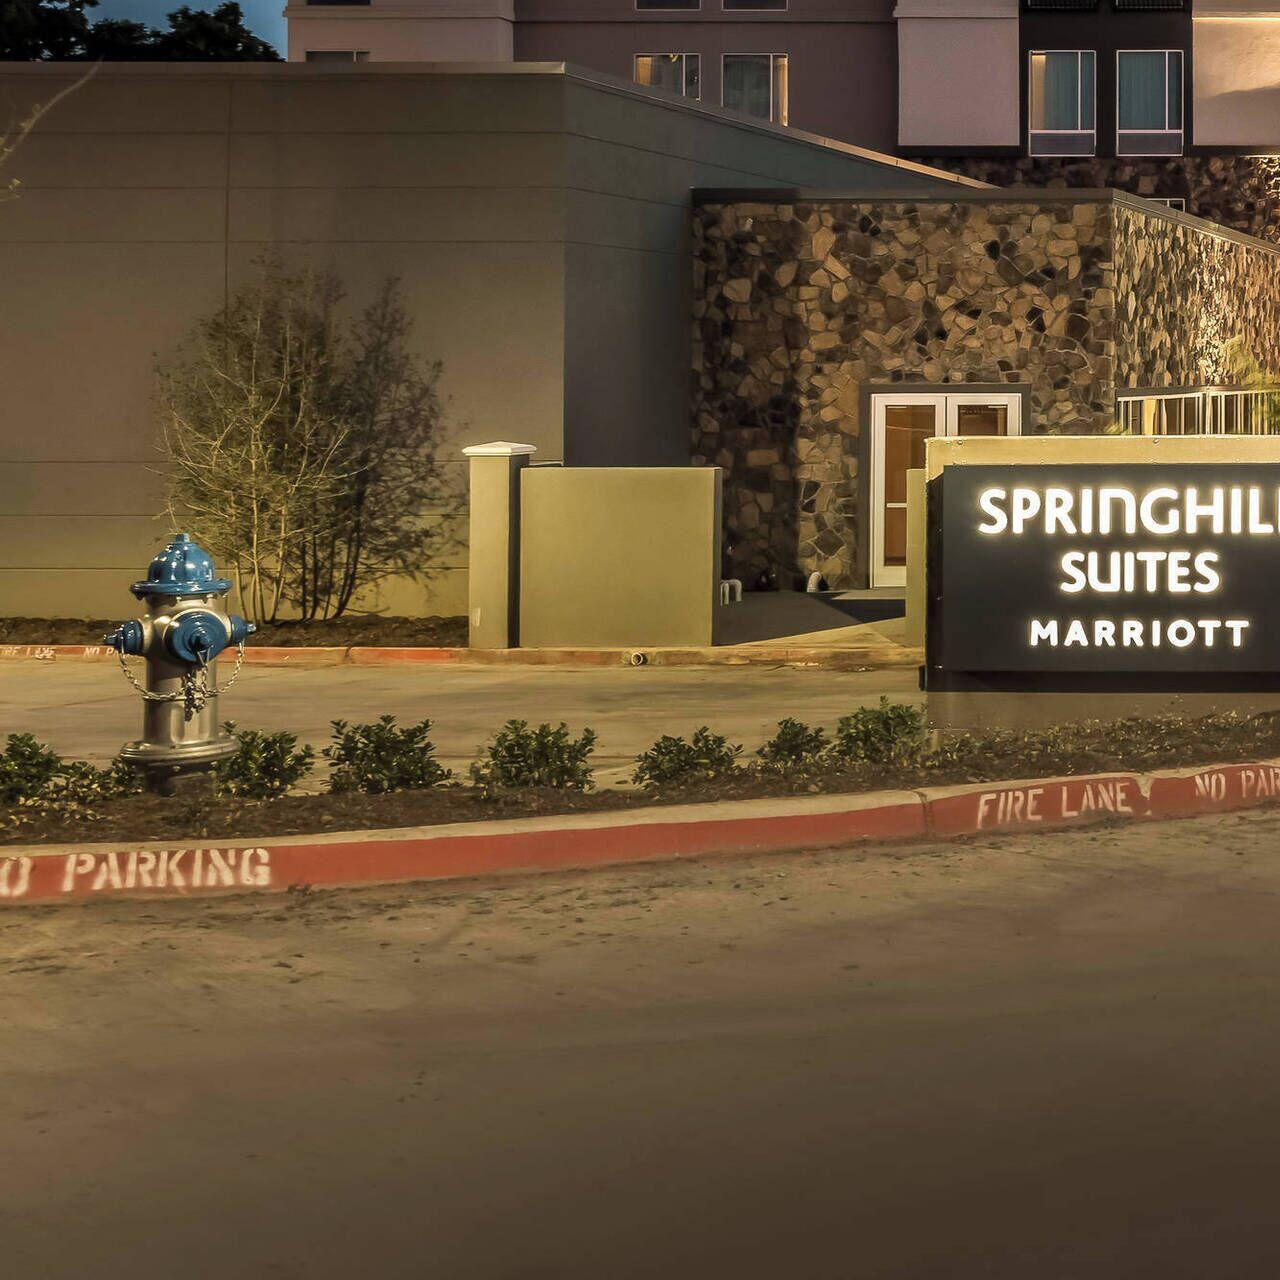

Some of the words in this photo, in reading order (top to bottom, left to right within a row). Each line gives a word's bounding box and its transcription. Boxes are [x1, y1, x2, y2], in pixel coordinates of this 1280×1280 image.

[1060, 551, 1221, 593] SUITES
[1030, 620, 1250, 647] MARRIOTT
[977, 787, 1045, 830] FIRE
[1061, 780, 1133, 818] LANE
[1194, 773, 1227, 802] NO
[0, 856, 32, 897] O
[61, 848, 272, 892] PARKING
